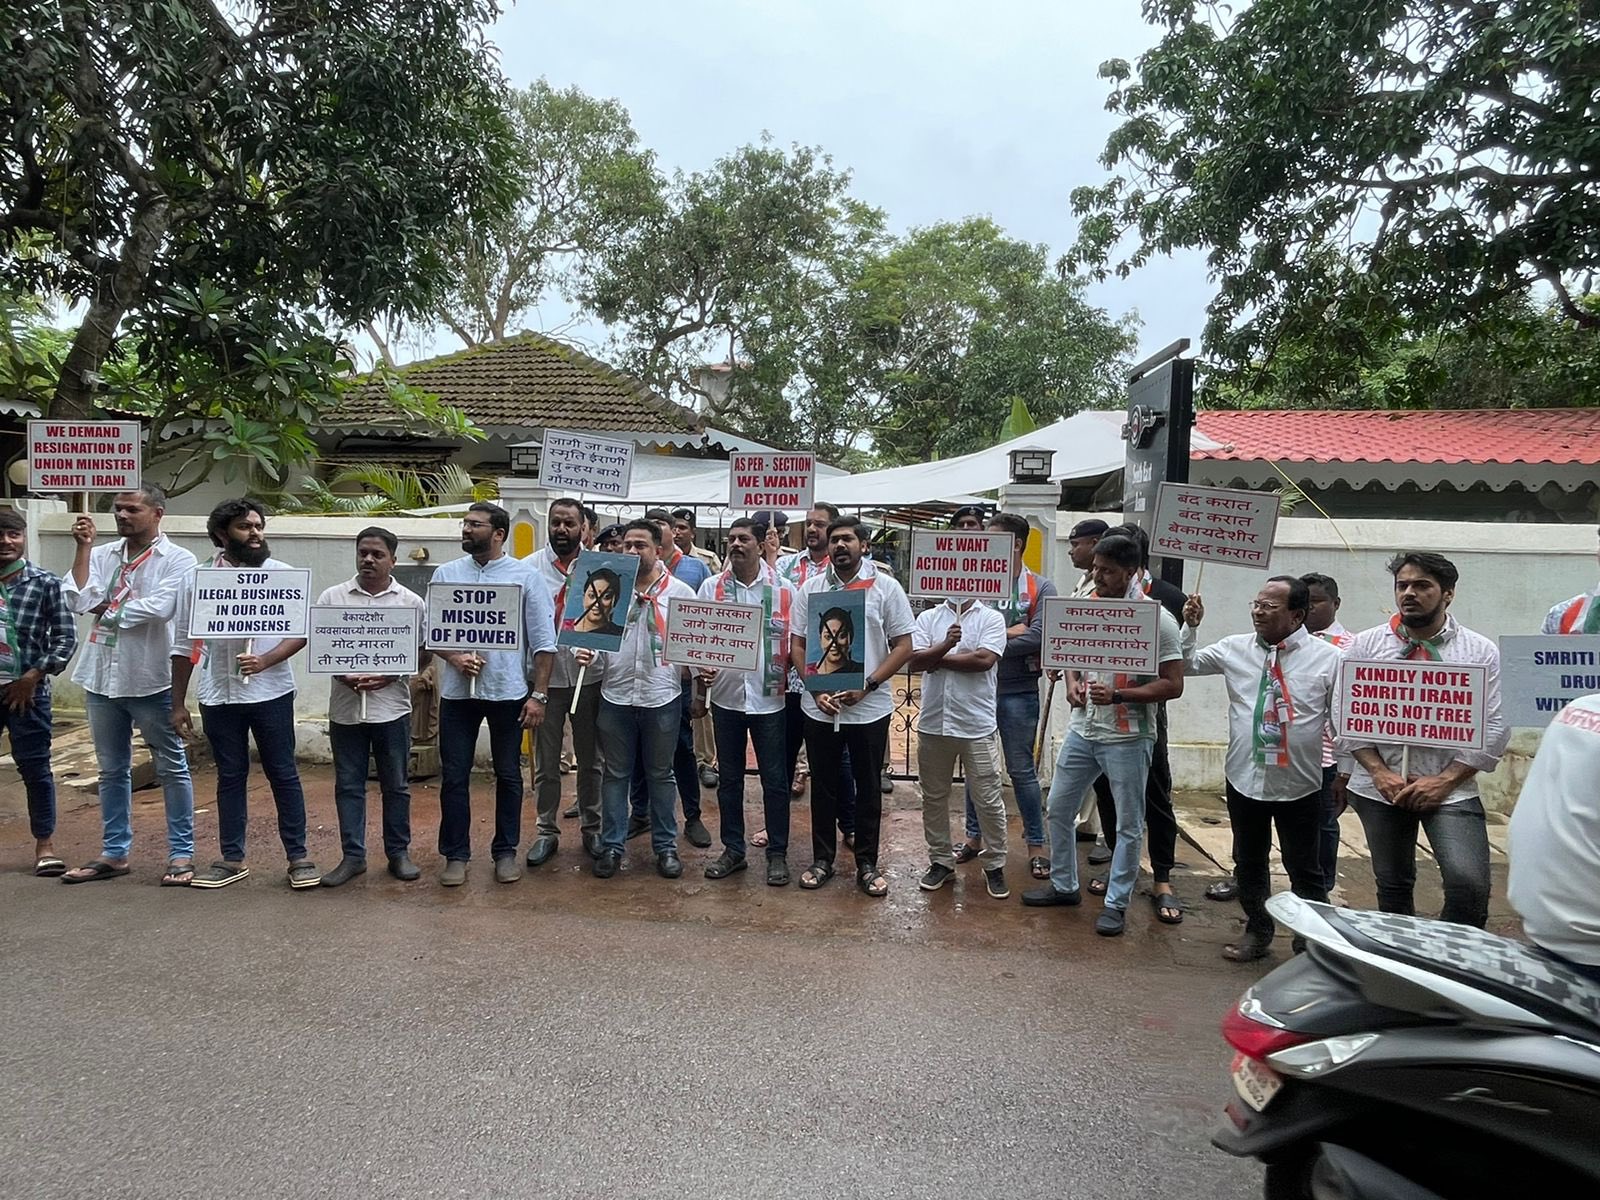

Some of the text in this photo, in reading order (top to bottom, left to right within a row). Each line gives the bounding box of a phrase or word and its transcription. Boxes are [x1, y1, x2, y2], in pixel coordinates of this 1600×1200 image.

[46, 426, 120, 438] WE DEMAND
[34, 442, 133, 454] RESIGNATION OF
[35, 458, 135, 470] UNION MINISTER
[549, 448, 626, 466] स्मृति ईराणी
[734, 457, 746, 472] AS
[748, 457, 763, 472] PER
[773, 457, 811, 472] SECTION
[41, 475, 125, 486] SMRITI IRANI
[593, 482, 621, 492] राणी
[737, 476, 807, 488] WE WANT
[744, 493, 798, 505] ACTION
[1178, 492, 1202, 506] बंद
[1206, 497, 1252, 511] करात
[1179, 508, 1254, 527] बंद करात
[1168, 521, 1258, 544] बेकायदेशीर
[936, 538, 989, 552] WE WANT
[1188, 541, 1213, 554] बंद
[1216, 547, 1263, 560] करात
[916, 557, 1007, 573] ACTION OR FACE
[237, 574, 268, 584] STOP
[921, 577, 1001, 593] OUR REACTION
[199, 589, 304, 600] ILEGAL BUSINESS.
[453, 590, 496, 604] STOP
[216, 605, 284, 615] IN OUR GOA
[442, 610, 506, 624] MISUSE
[678, 604, 752, 620] भाजपा सरकार
[208, 621, 290, 632] NO NONSENSE
[367, 627, 390, 635] मारता
[683, 619, 745, 633] जागे जायात
[1059, 623, 1142, 634] पालन करात
[432, 628, 516, 644] OF POWER
[358, 640, 395, 648] मारला
[729, 639, 755, 650] वापर
[318, 653, 407, 669] ती स्मृति ईराणी
[706, 652, 735, 663] करात
[1051, 653, 1147, 667] कारवाय करात
[1534, 651, 1594, 665] SMRITI
[1356, 667, 1470, 687] KINDLY NOTE
[1561, 675, 1600, 689] DRU
[1351, 684, 1472, 705] SMRITI IRANI
[1535, 698, 1574, 711] WIT
[1351, 701, 1471, 723] GOA IS NOT FREE
[1347, 718, 1475, 742] FOR YOUR FAMILY
